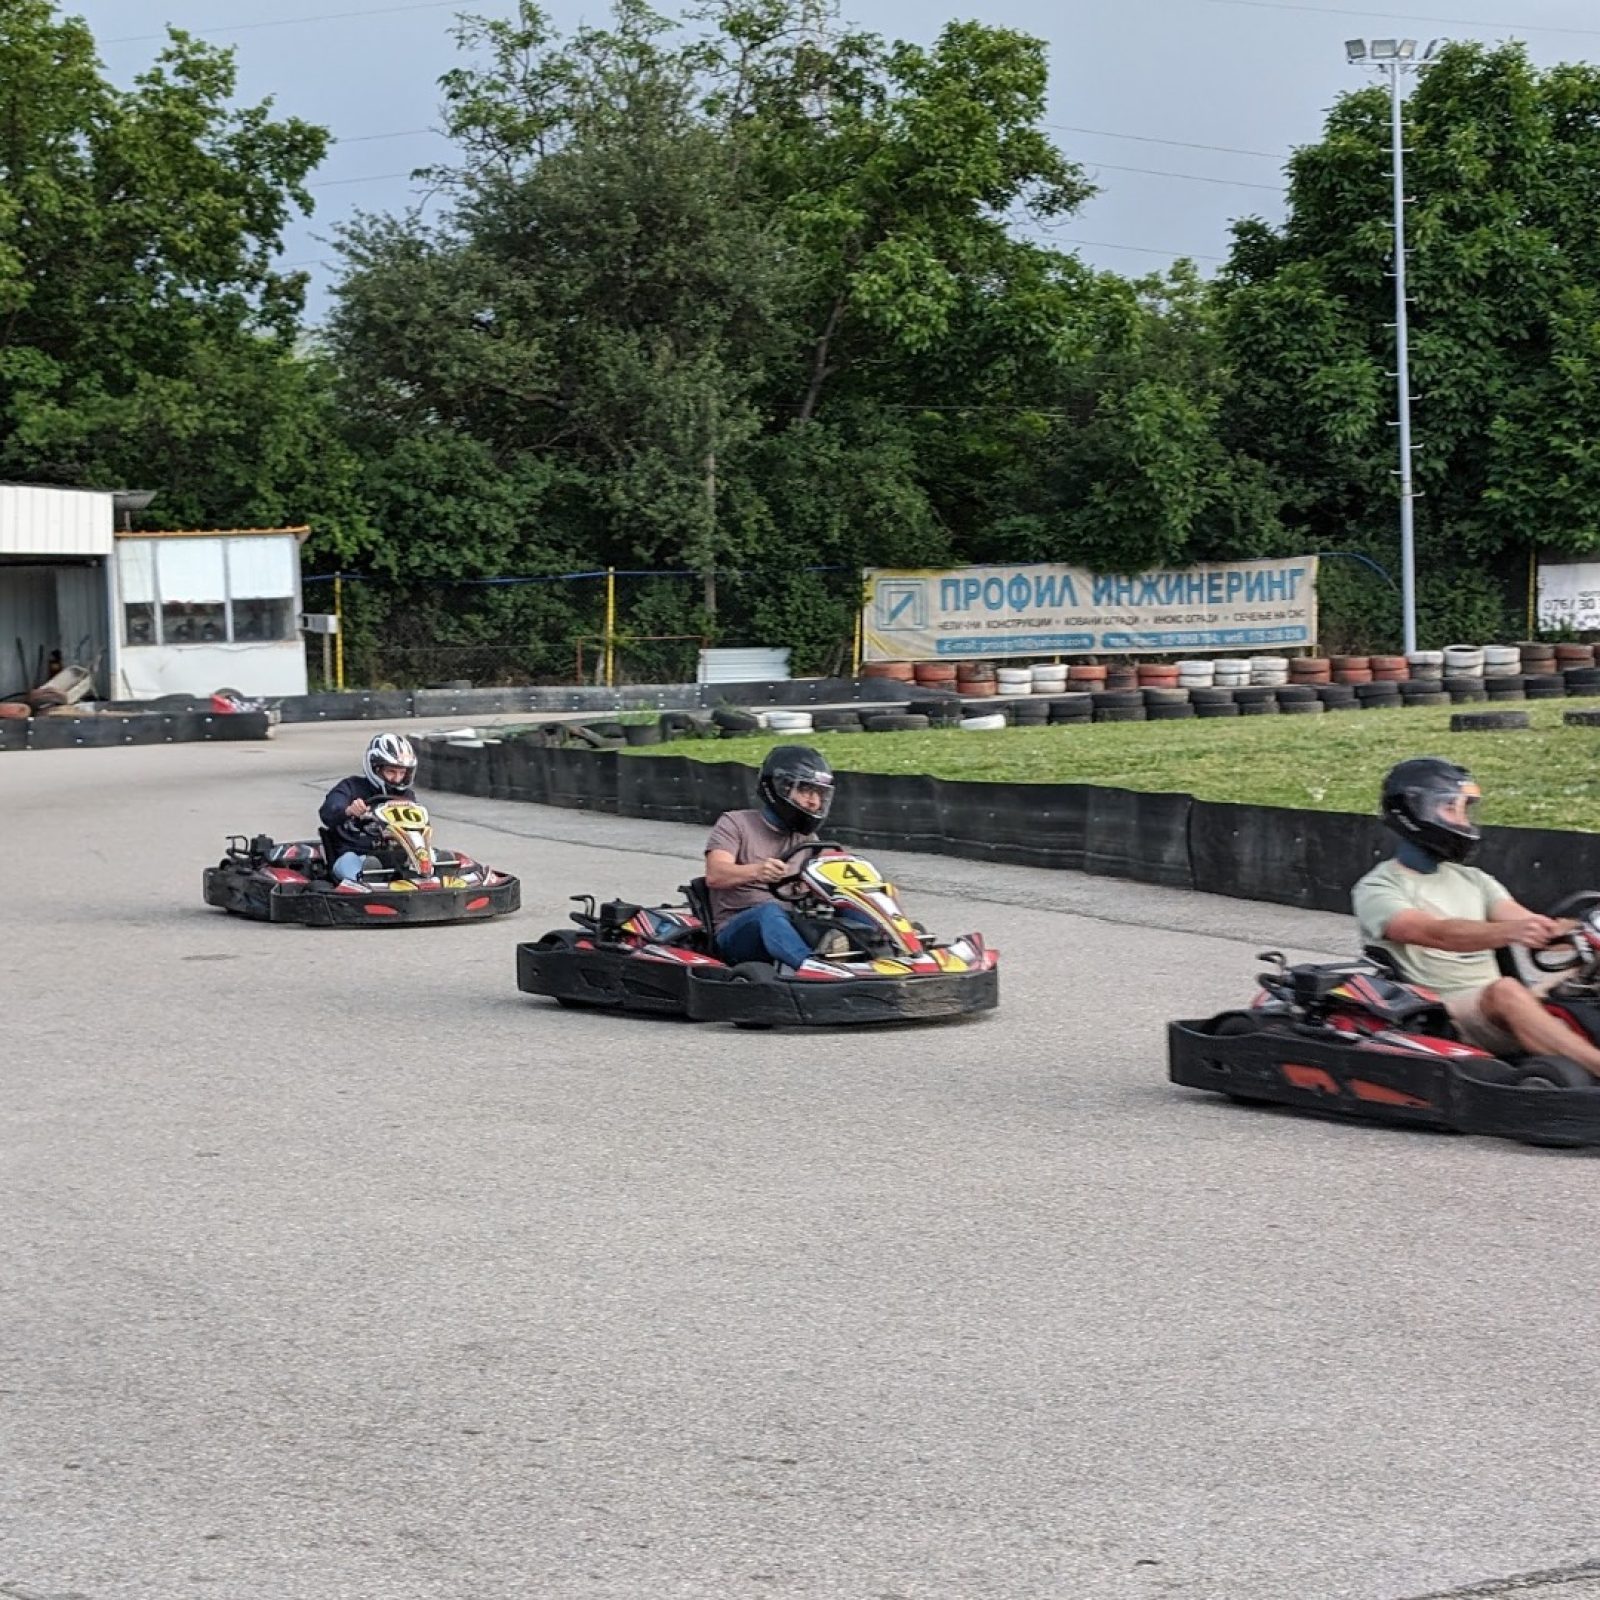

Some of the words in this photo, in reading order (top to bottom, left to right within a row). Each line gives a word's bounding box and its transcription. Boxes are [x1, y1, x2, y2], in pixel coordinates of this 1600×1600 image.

[940, 573, 1079, 612] ПРОФИЛ
[1092, 568, 1306, 607] ИНЖИНЕРИНГ
[387, 808, 421, 822] 16
[842, 863, 869, 882] 4
